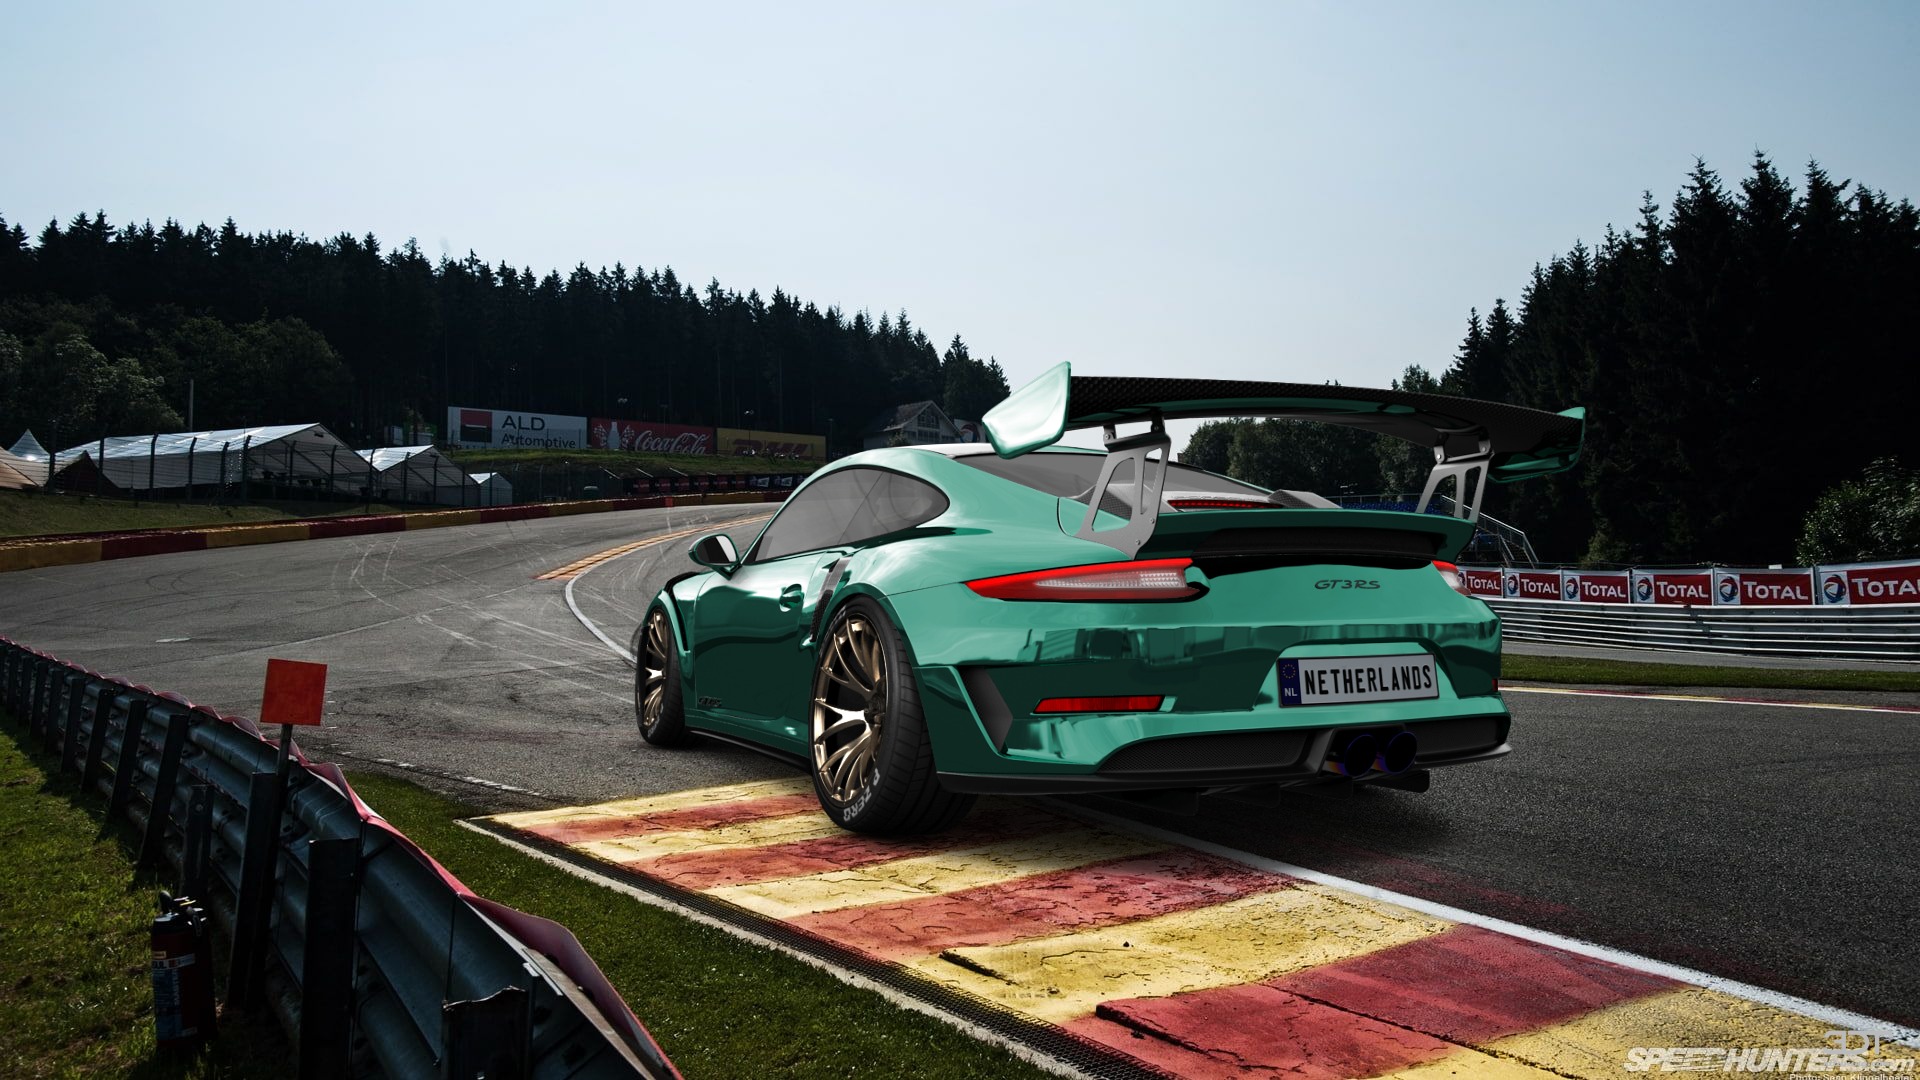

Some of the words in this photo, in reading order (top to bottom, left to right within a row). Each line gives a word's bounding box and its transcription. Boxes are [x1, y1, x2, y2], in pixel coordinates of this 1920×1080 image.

[501, 415, 545, 431] ALD
[501, 433, 576, 449] Automotive
[1467, 575, 1501, 590] TOTAL
[1520, 578, 1560, 594] TOTAL
[1581, 581, 1627, 598] TOTAL
[1656, 581, 1709, 598] TOTAL
[1742, 581, 1809, 600] TOTAL
[1304, 664, 1432, 695] NETHERLANDS
[1284, 687, 1298, 697] NL
[872, 767, 881, 788] P
[843, 787, 873, 822] ZERO
